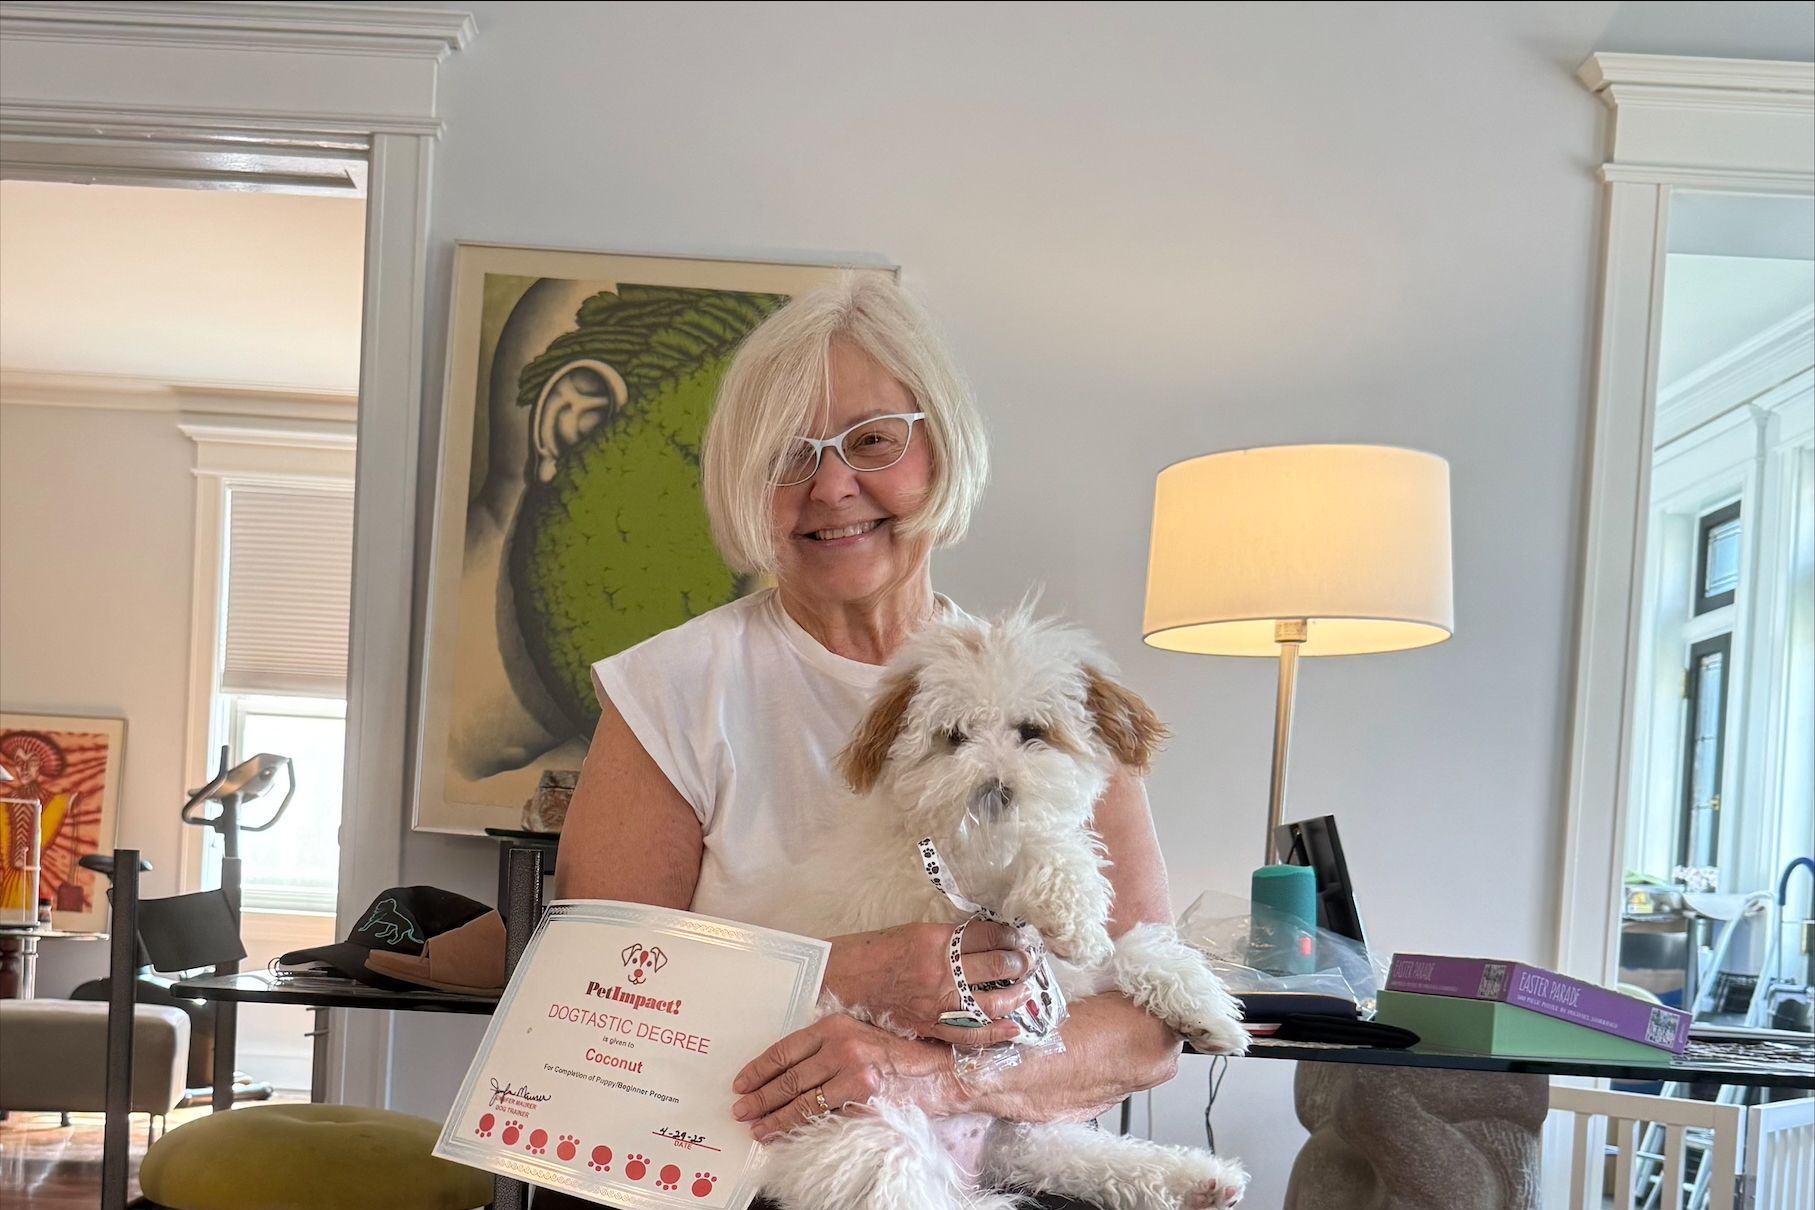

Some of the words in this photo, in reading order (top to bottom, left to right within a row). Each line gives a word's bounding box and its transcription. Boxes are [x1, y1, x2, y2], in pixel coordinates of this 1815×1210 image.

[585, 981, 682, 1015] PetImpact!
[1519, 972, 1551, 999] EASTER
[1550, 981, 1581, 1007] PARADE
[548, 1004, 633, 1034] DOGTASTIC
[636, 1022, 711, 1054] DEGREE
[602, 1035, 609, 1043] is
[609, 1037, 626, 1047] given
[627, 1041, 635, 1049] to
[585, 1048, 643, 1074] Coconut
[543, 1063, 554, 1071] For
[554, 1066, 588, 1080] Completion
[587, 1074, 596, 1082] of
[595, 1076, 649, 1096] Puppy/Beginner
[649, 1089, 680, 1104] Program
[495, 1104, 507, 1113] DOG
[506, 1107, 530, 1118] TRAINER
[660, 1127, 706, 1143] 4-29-25
[673, 1140, 692, 1150] DATE
